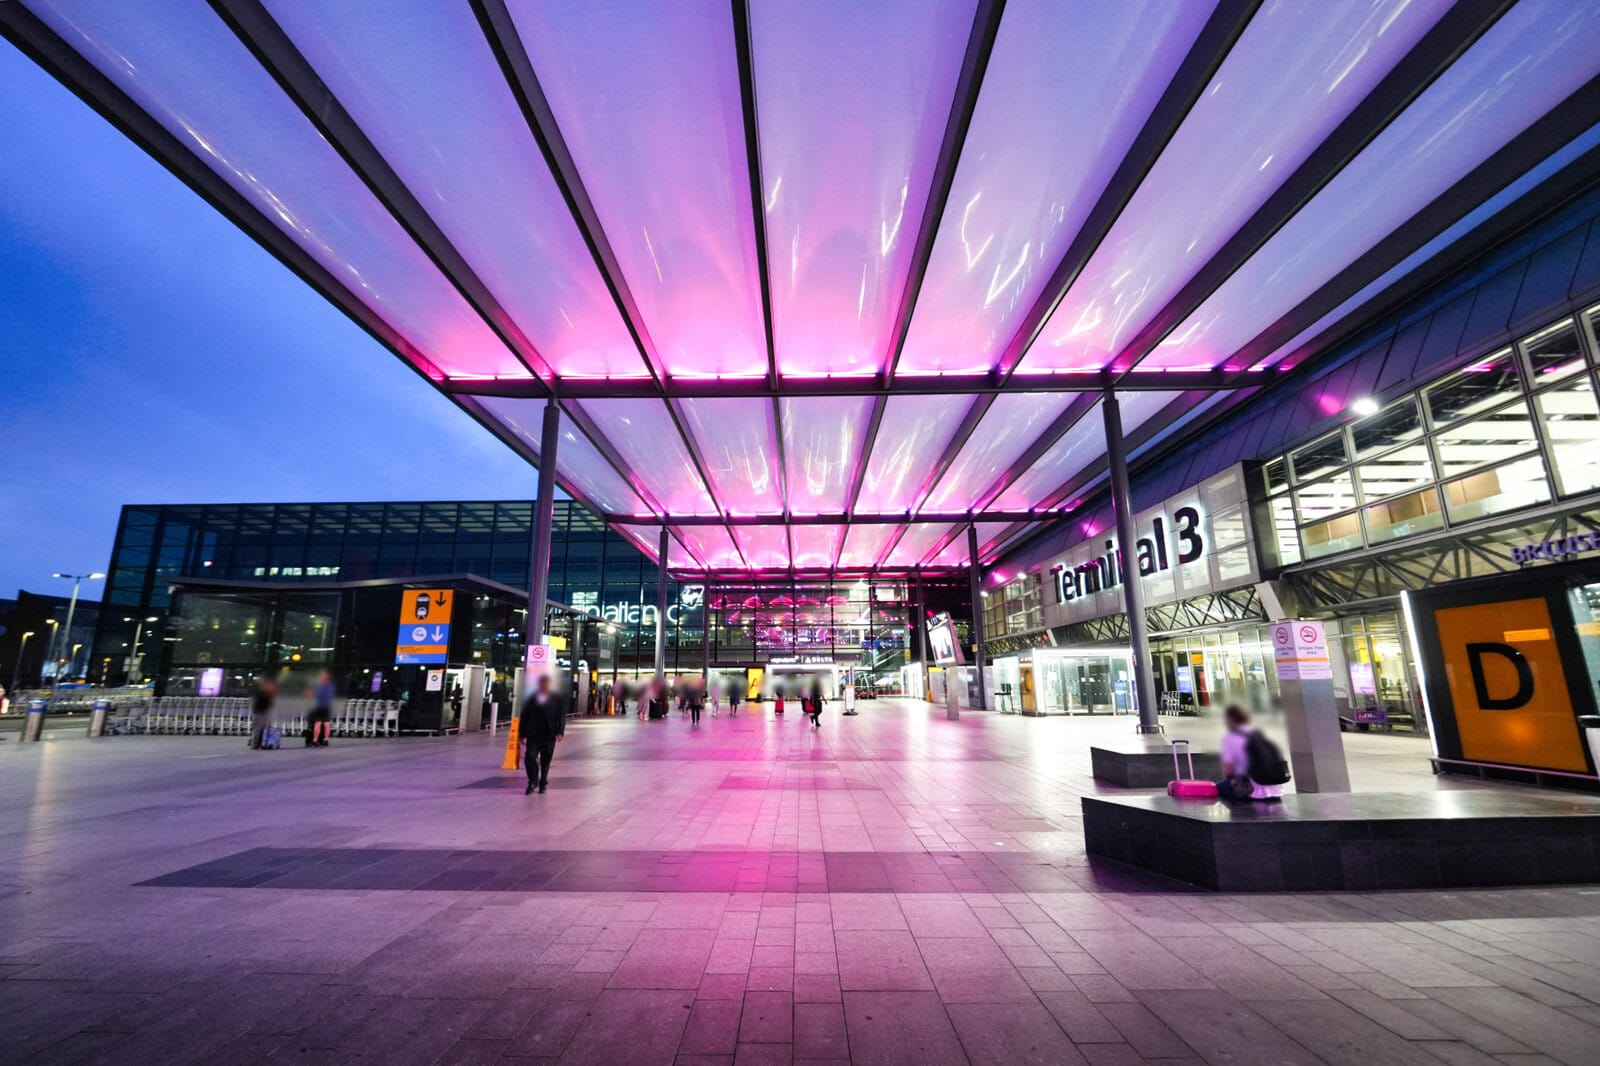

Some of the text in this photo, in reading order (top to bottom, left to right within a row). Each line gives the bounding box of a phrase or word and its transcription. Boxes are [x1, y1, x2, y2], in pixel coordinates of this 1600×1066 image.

[1050, 507, 1203, 603] Termial 3
[1466, 642, 1534, 710] D
